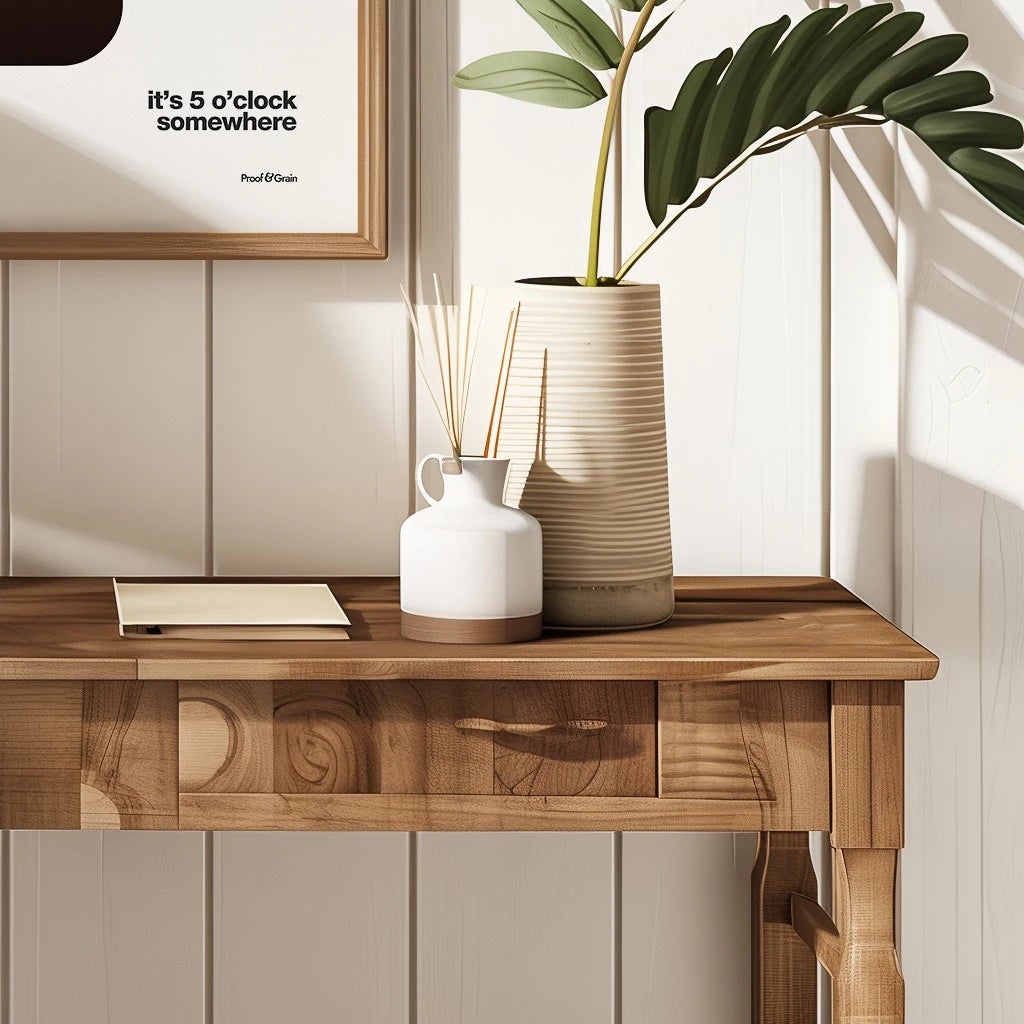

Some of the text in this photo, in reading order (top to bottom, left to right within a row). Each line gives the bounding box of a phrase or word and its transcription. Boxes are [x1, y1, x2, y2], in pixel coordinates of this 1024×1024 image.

[147, 90, 298, 110] it’s 5 o’clock
[156, 111, 298, 131] somewhere
